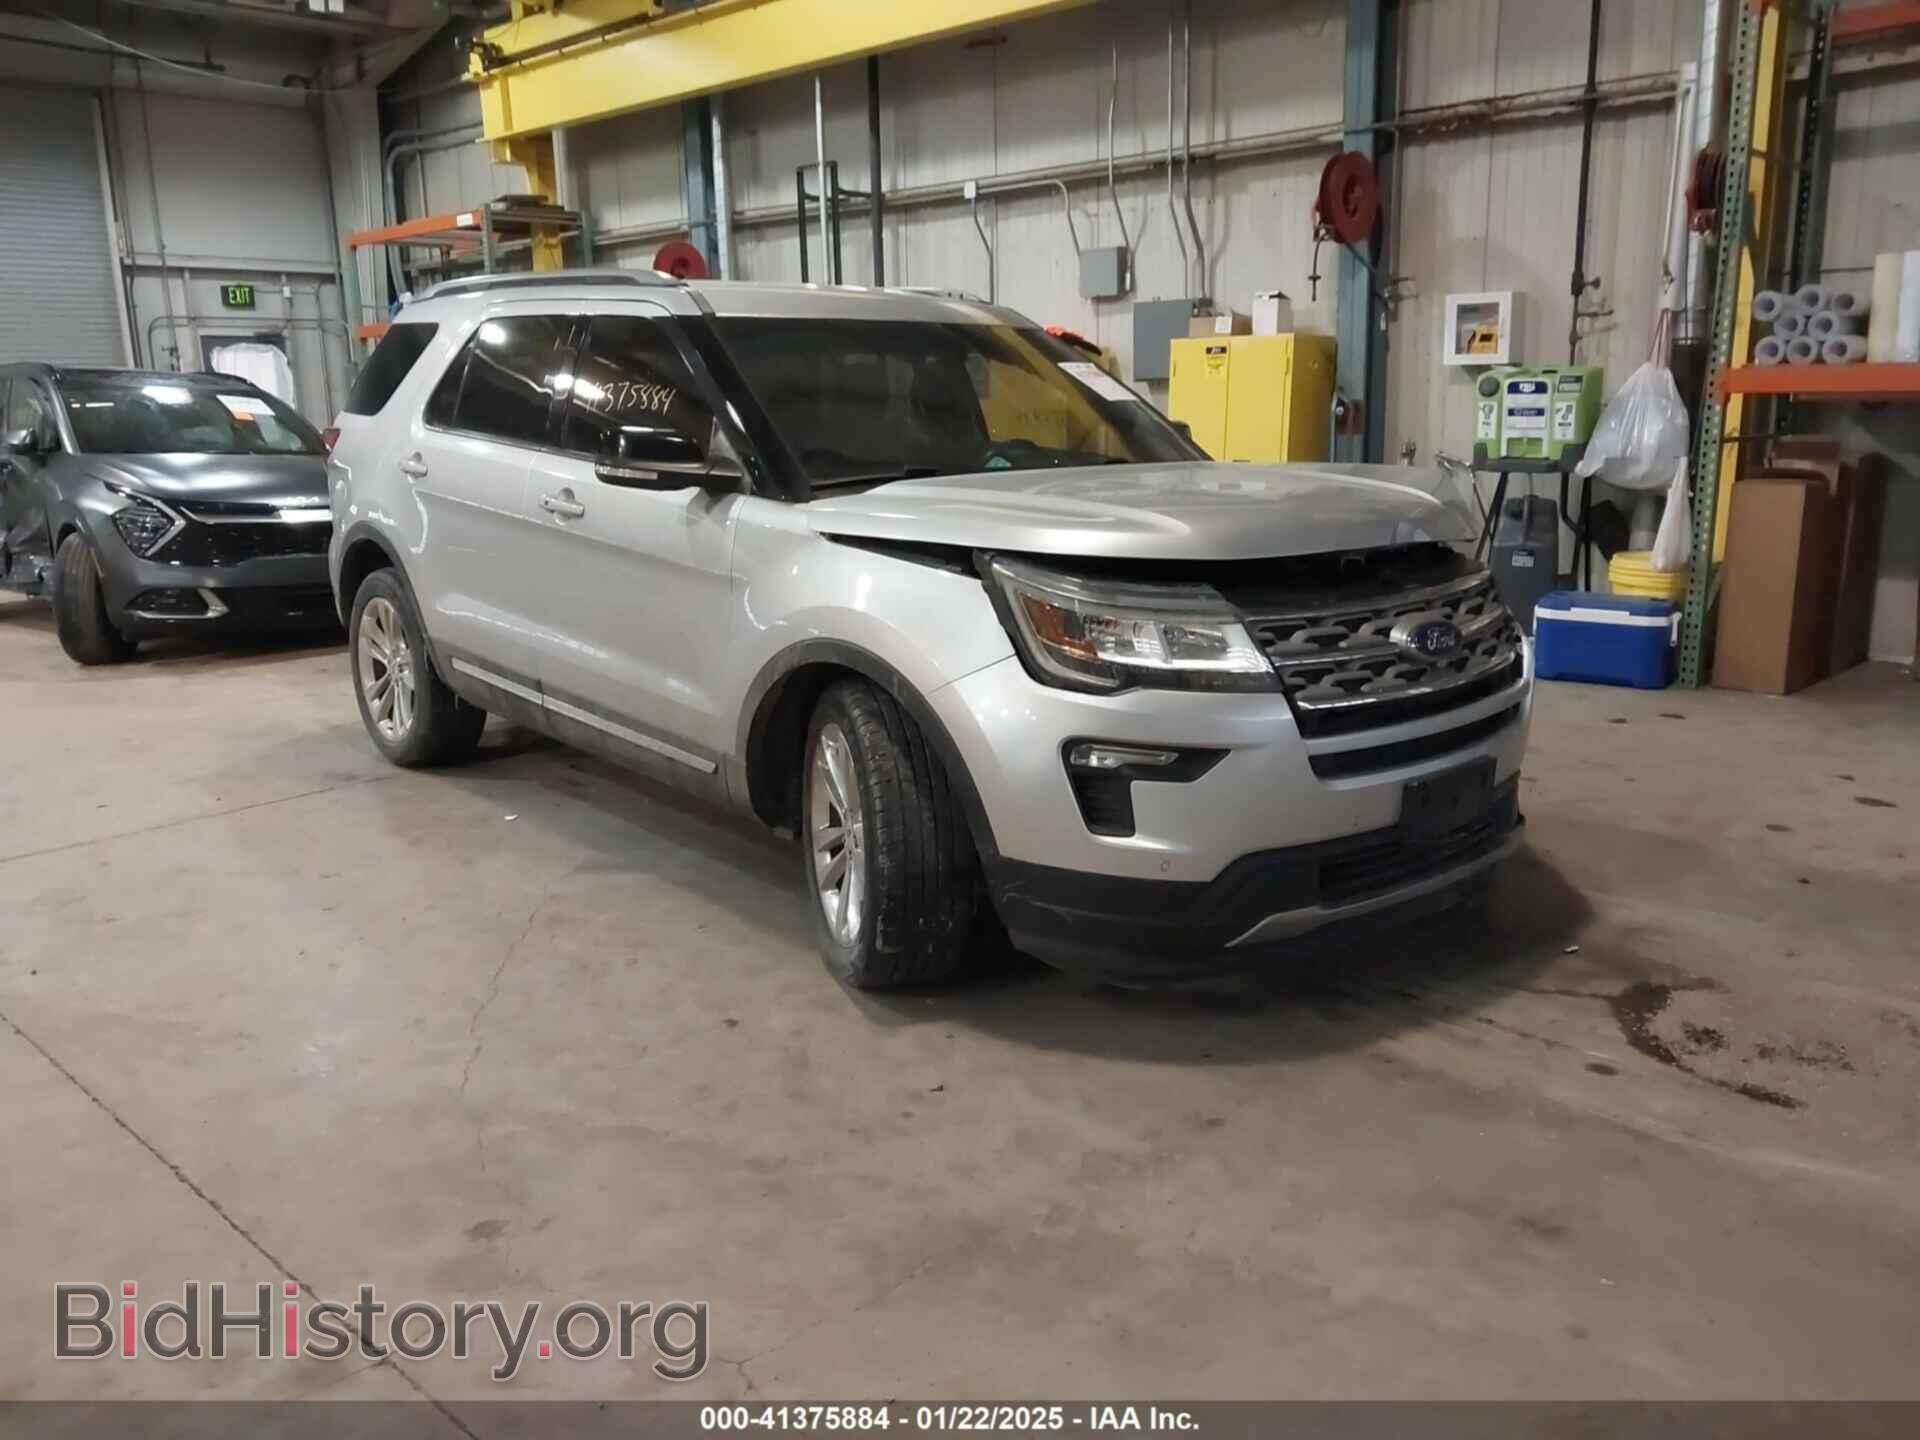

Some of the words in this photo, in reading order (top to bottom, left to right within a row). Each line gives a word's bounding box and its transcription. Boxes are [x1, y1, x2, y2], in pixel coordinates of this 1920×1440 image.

[228, 287, 250, 305] EXIT
[585, 380, 677, 416] 375884
[1426, 625, 1456, 651] Ford
